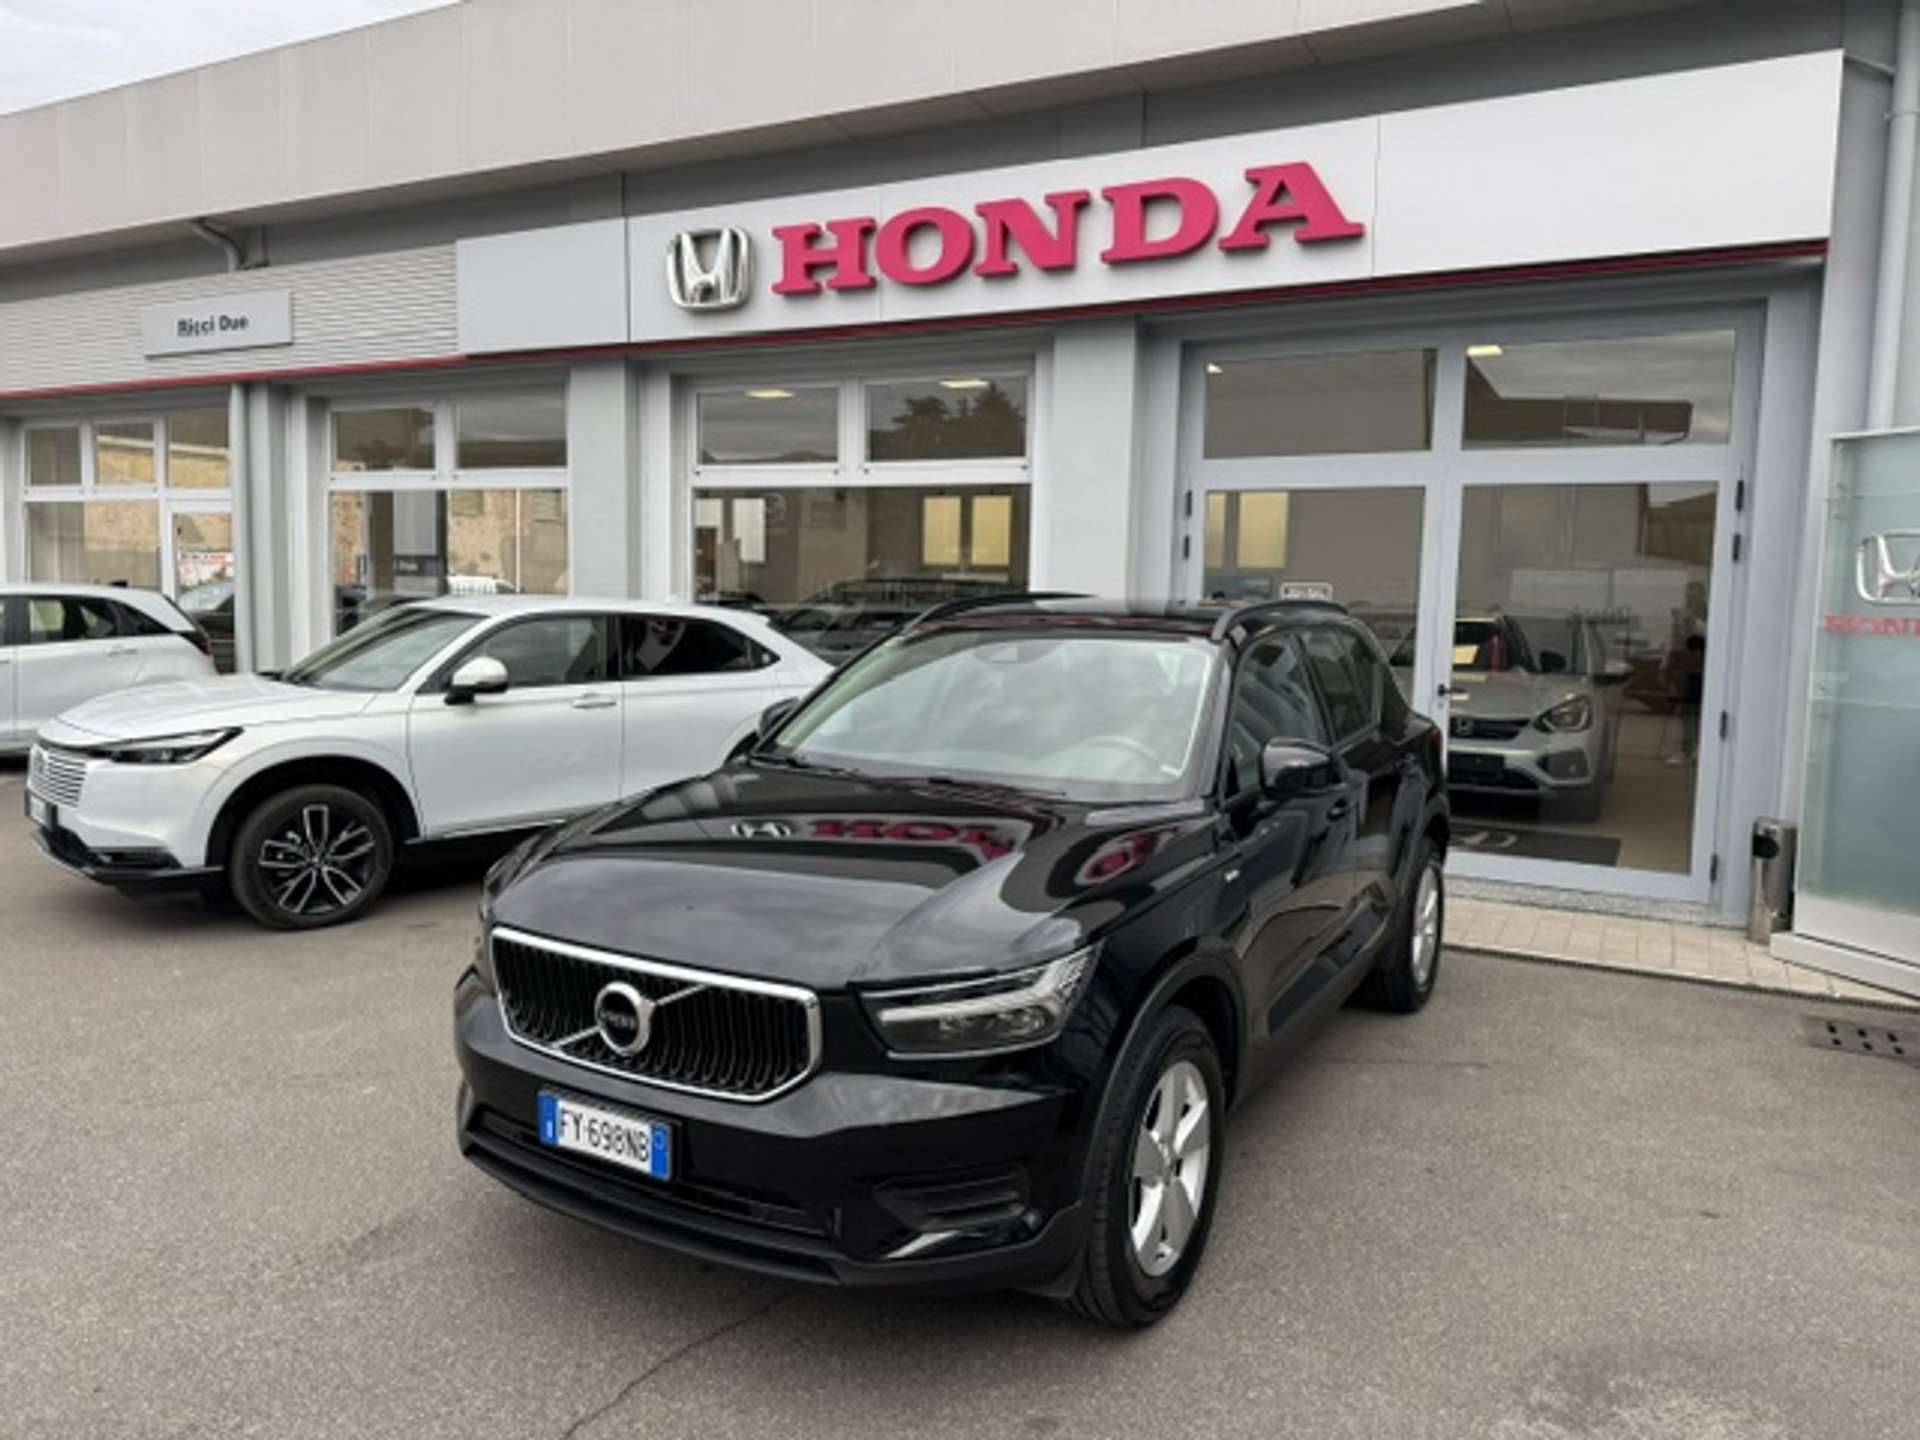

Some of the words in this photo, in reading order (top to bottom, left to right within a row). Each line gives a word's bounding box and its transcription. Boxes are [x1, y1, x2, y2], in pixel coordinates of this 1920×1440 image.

[771, 161, 1365, 297] HONDA
[177, 315, 215, 337] Ricci
[219, 314, 248, 331] Due
